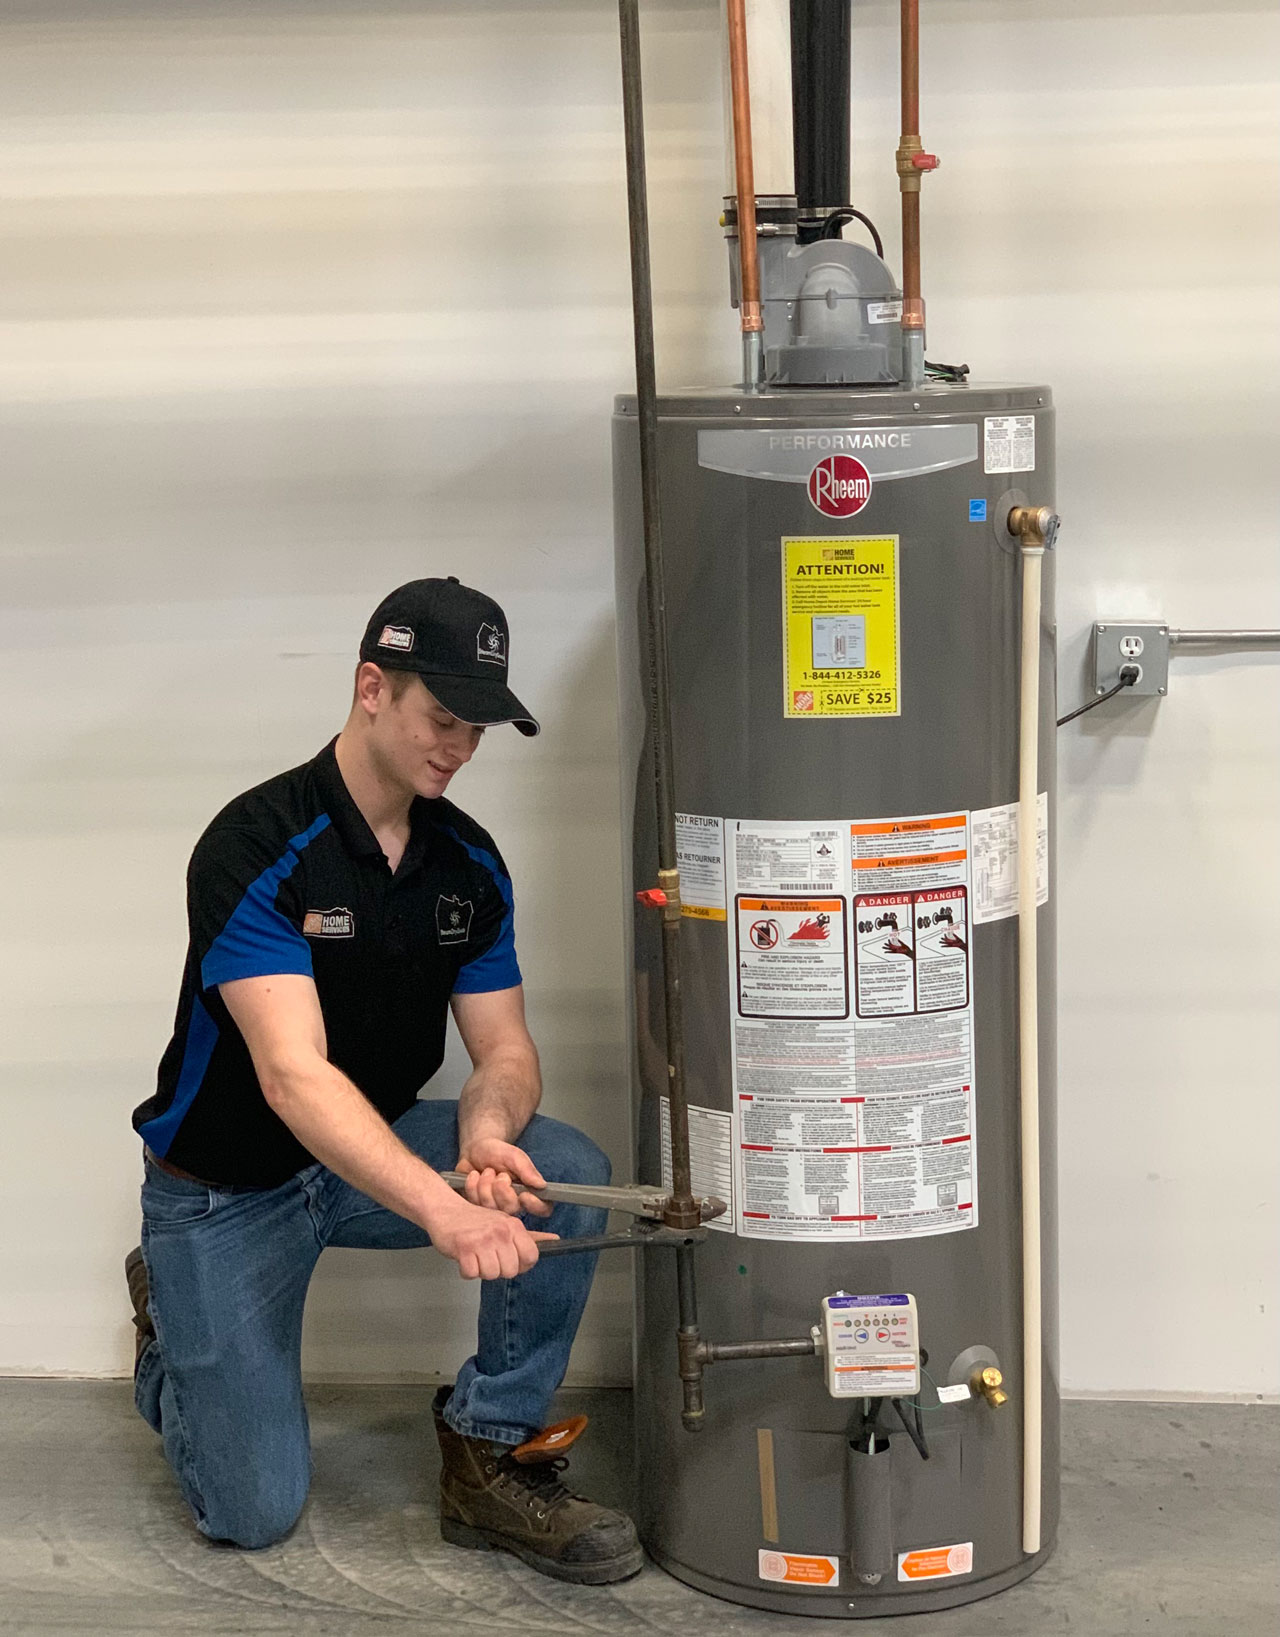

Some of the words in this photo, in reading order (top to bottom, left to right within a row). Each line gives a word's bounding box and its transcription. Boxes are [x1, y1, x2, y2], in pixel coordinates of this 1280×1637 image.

[769, 433, 912, 450] PERFORMANCE
[816, 456, 868, 508] Rheem
[796, 563, 885, 576] ATTENTION!
[802, 670, 881, 680] 1-844-412-5326
[826, 693, 860, 705] SAVE
[867, 692, 892, 704] $25
[689, 816, 719, 828] RETURN
[902, 823, 931, 831] WARNING
[684, 853, 721, 864] RETOURNER
[869, 896, 909, 906] DANGER
[927, 890, 963, 901] DANGER
[323, 916, 350, 927] HOME
